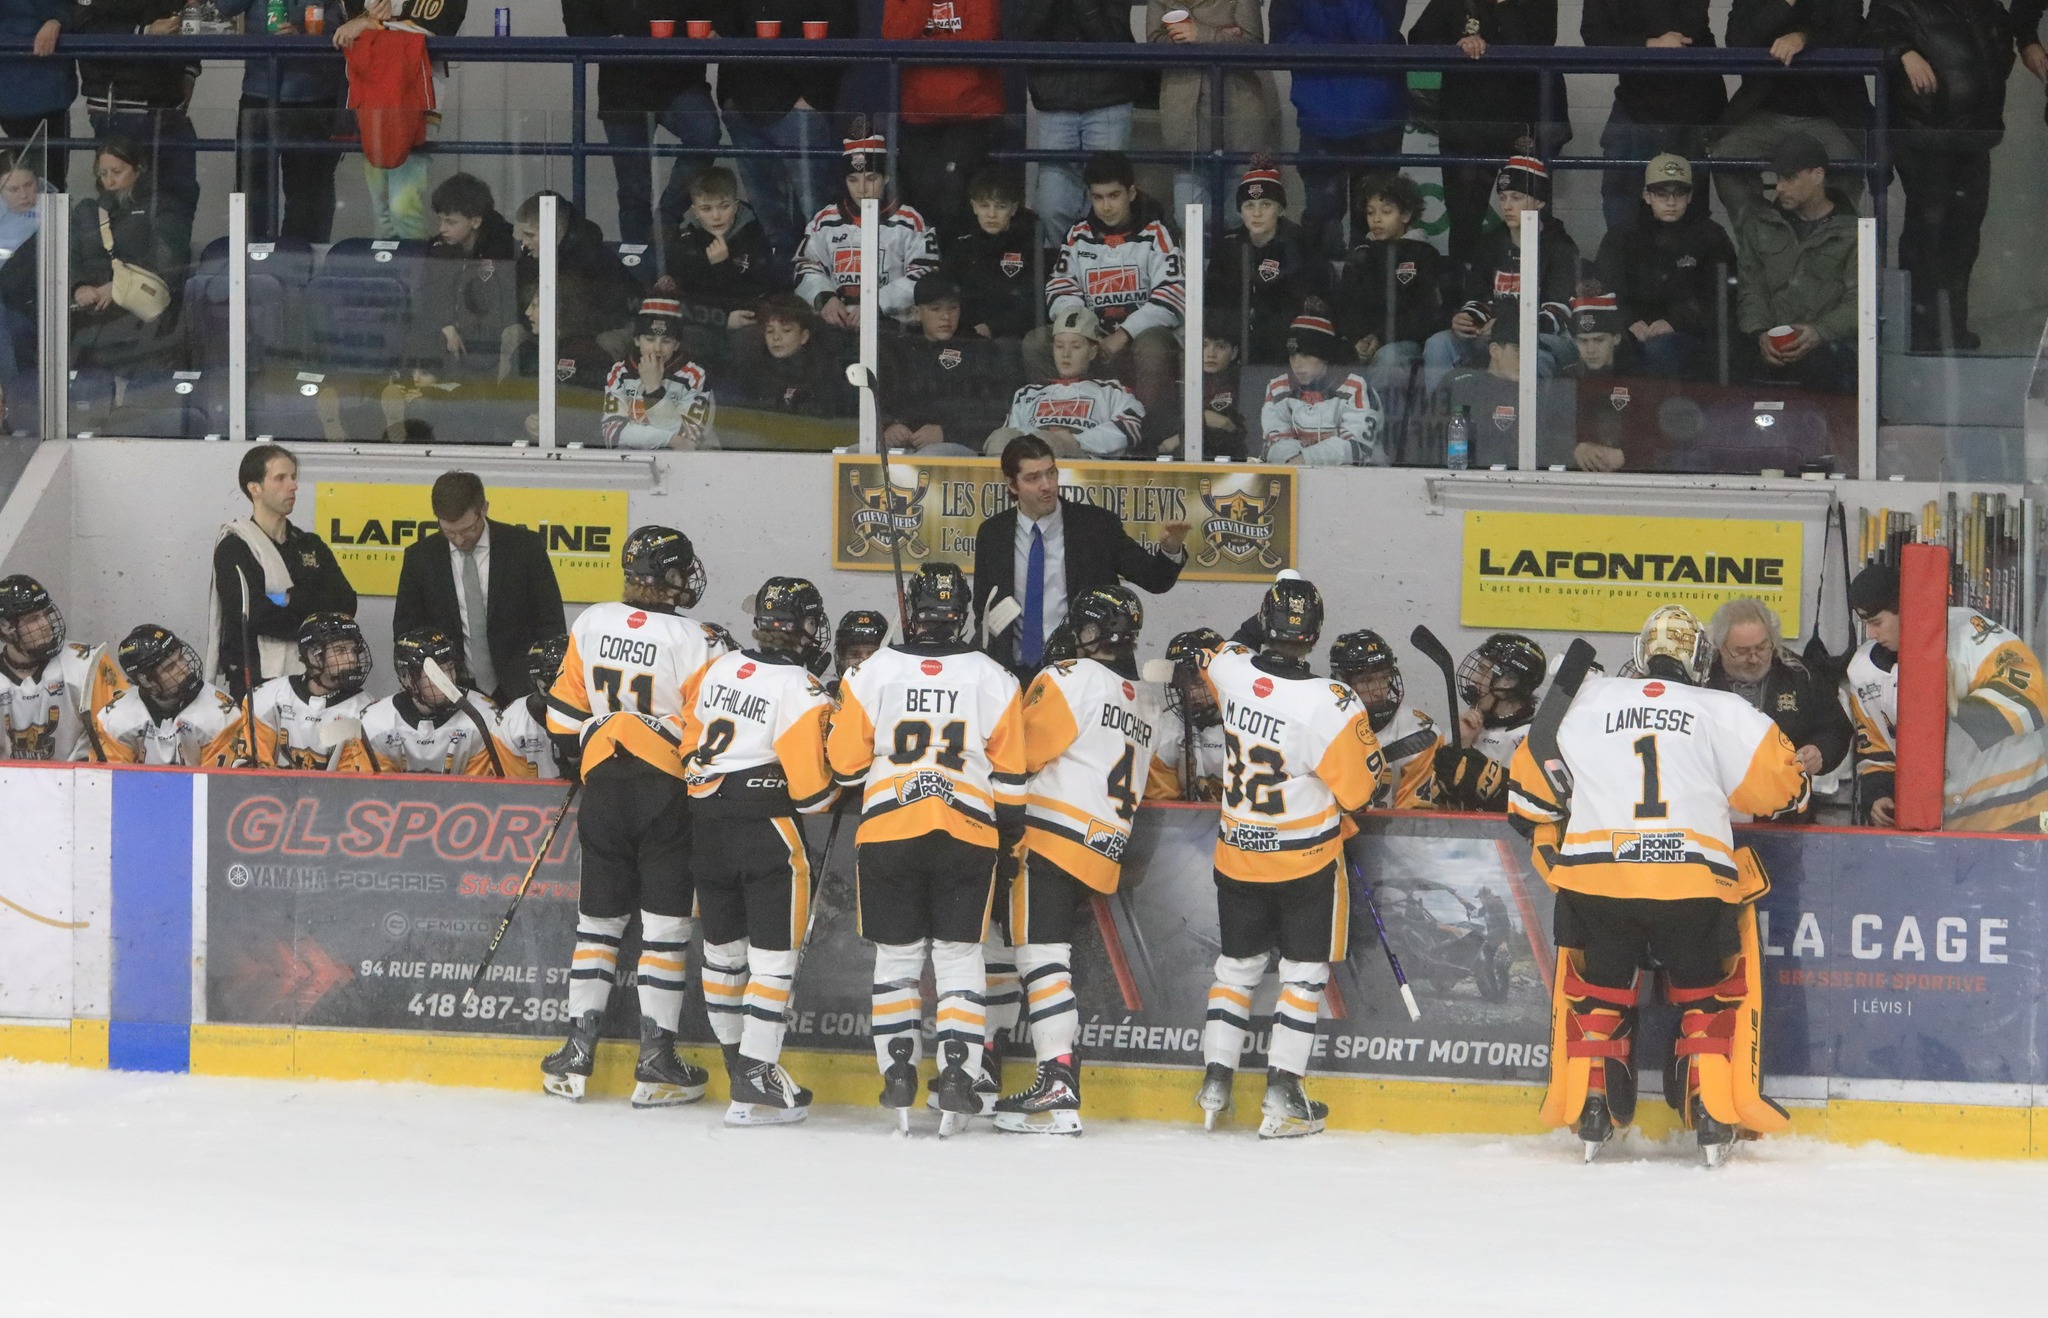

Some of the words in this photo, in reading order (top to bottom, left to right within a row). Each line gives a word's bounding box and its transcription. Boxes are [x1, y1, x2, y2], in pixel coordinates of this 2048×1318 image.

[1095, 291, 1147, 306] CANAM
[1039, 417, 1096, 429] CANAM
[942, 482, 976, 518] LES
[1103, 487, 1129, 522] DE
[1133, 480, 1187, 522] LÉVIS
[1208, 520, 1270, 538] CHEVALIERS
[367, 553, 378, 561] et
[385, 552, 396, 562] le
[560, 558, 610, 569] l'avenir
[626, 555, 635, 563] 71
[1480, 548, 1784, 586] LAFONTAINE
[939, 591, 951, 600] 91
[1480, 583, 1511, 593] L'art
[1518, 584, 1531, 594] et
[1539, 585, 1550, 594] le
[1558, 587, 1601, 596] savoir
[1609, 589, 1639, 598] pour
[1647, 590, 1720, 600] construire
[766, 601, 773, 610] 8
[854, 626, 875, 634] CCM
[1289, 616, 1301, 625] 92
[600, 635, 657, 667] CORSO
[593, 666, 655, 713] 71
[906, 688, 959, 714] BETY
[1225, 699, 1286, 745] M.COTE
[1606, 707, 1694, 735] LAINESSE
[1633, 734, 1669, 821] 1
[227, 796, 331, 855] GL
[1643, 850, 1684, 860] POINT
[251, 865, 326, 890] YAMAHA
[336, 872, 446, 891] POLARIS
[1715, 878, 1732, 888] CCM
[1759, 911, 1824, 957] LA
[1851, 914, 2009, 963] CAGE
[361, 960, 384, 977] 94
[389, 961, 427, 979] RUE
[1779, 970, 1886, 989] BRASSERIE
[1892, 973, 1987, 992] SPORTIVE
[408, 993, 456, 1017] 418
[1334, 1035, 1425, 1063] SPORT
[1428, 1040, 1550, 1068] MOTORIS
[1751, 1008, 1759, 1085] TRUE
